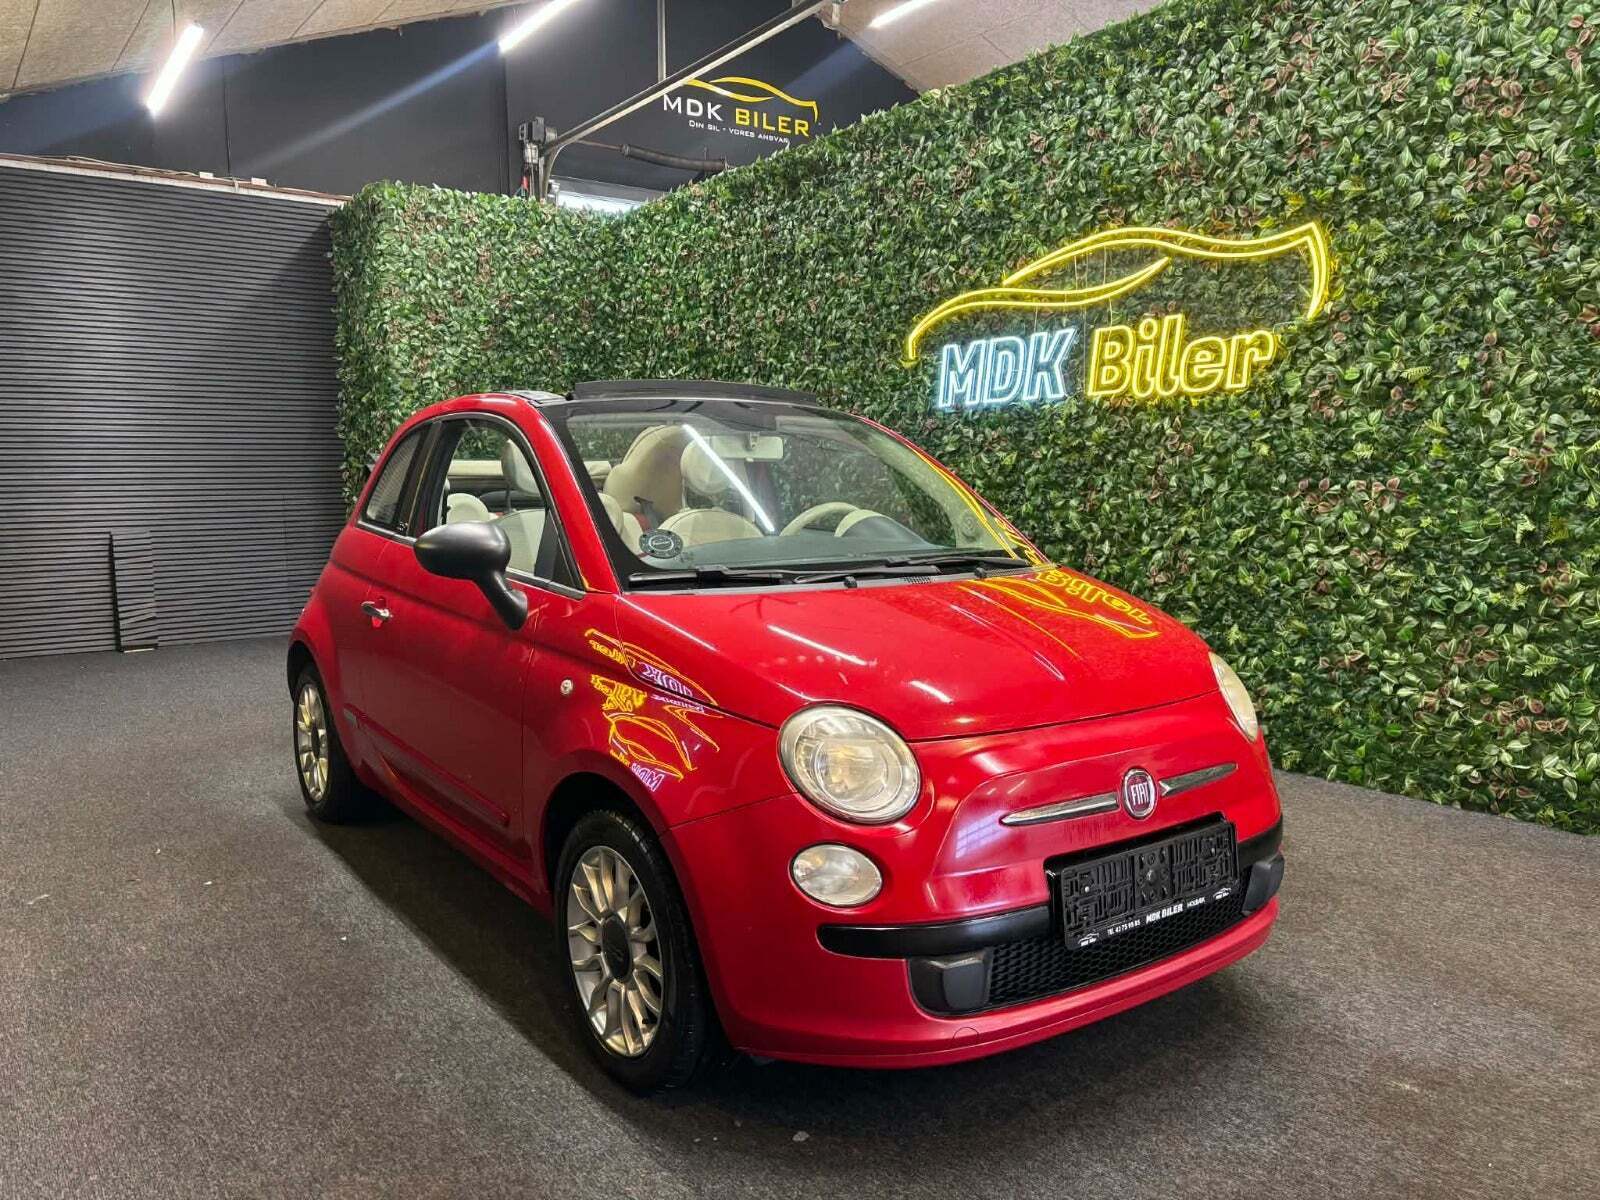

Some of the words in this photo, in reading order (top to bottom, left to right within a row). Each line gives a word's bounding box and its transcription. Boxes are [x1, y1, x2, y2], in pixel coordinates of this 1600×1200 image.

[663, 94, 724, 121] MDK
[735, 108, 810, 137] BILER
[729, 127, 755, 138] VORES
[938, 327, 1079, 408] MDK
[1086, 314, 1278, 398] Biler
[1130, 782, 1149, 806] FIAT
[1161, 903, 1184, 918] BILER
